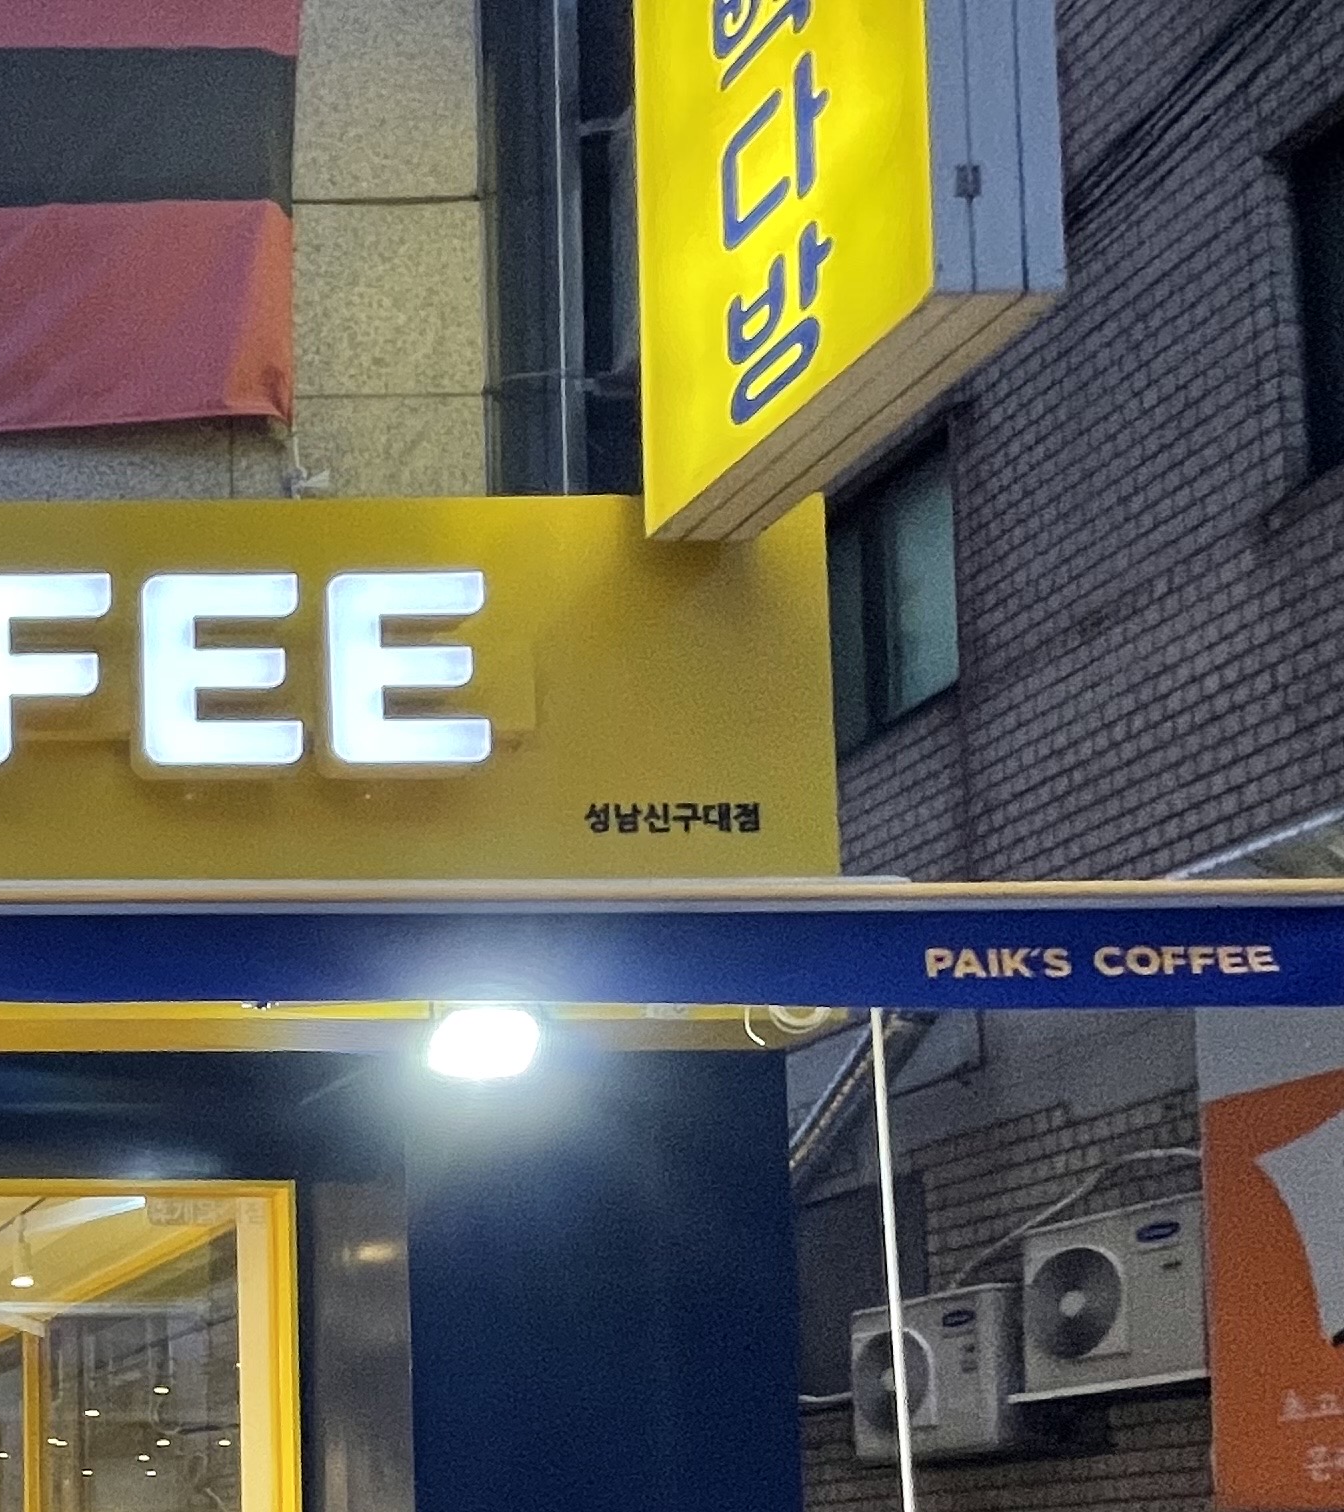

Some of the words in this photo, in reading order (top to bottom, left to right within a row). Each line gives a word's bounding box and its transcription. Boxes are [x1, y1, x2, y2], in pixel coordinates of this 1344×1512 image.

[584, 802, 760, 834] 성남신구대점
[924, 946, 1072, 979] PAIK'S
[1094, 945, 1281, 977] COFFEE
